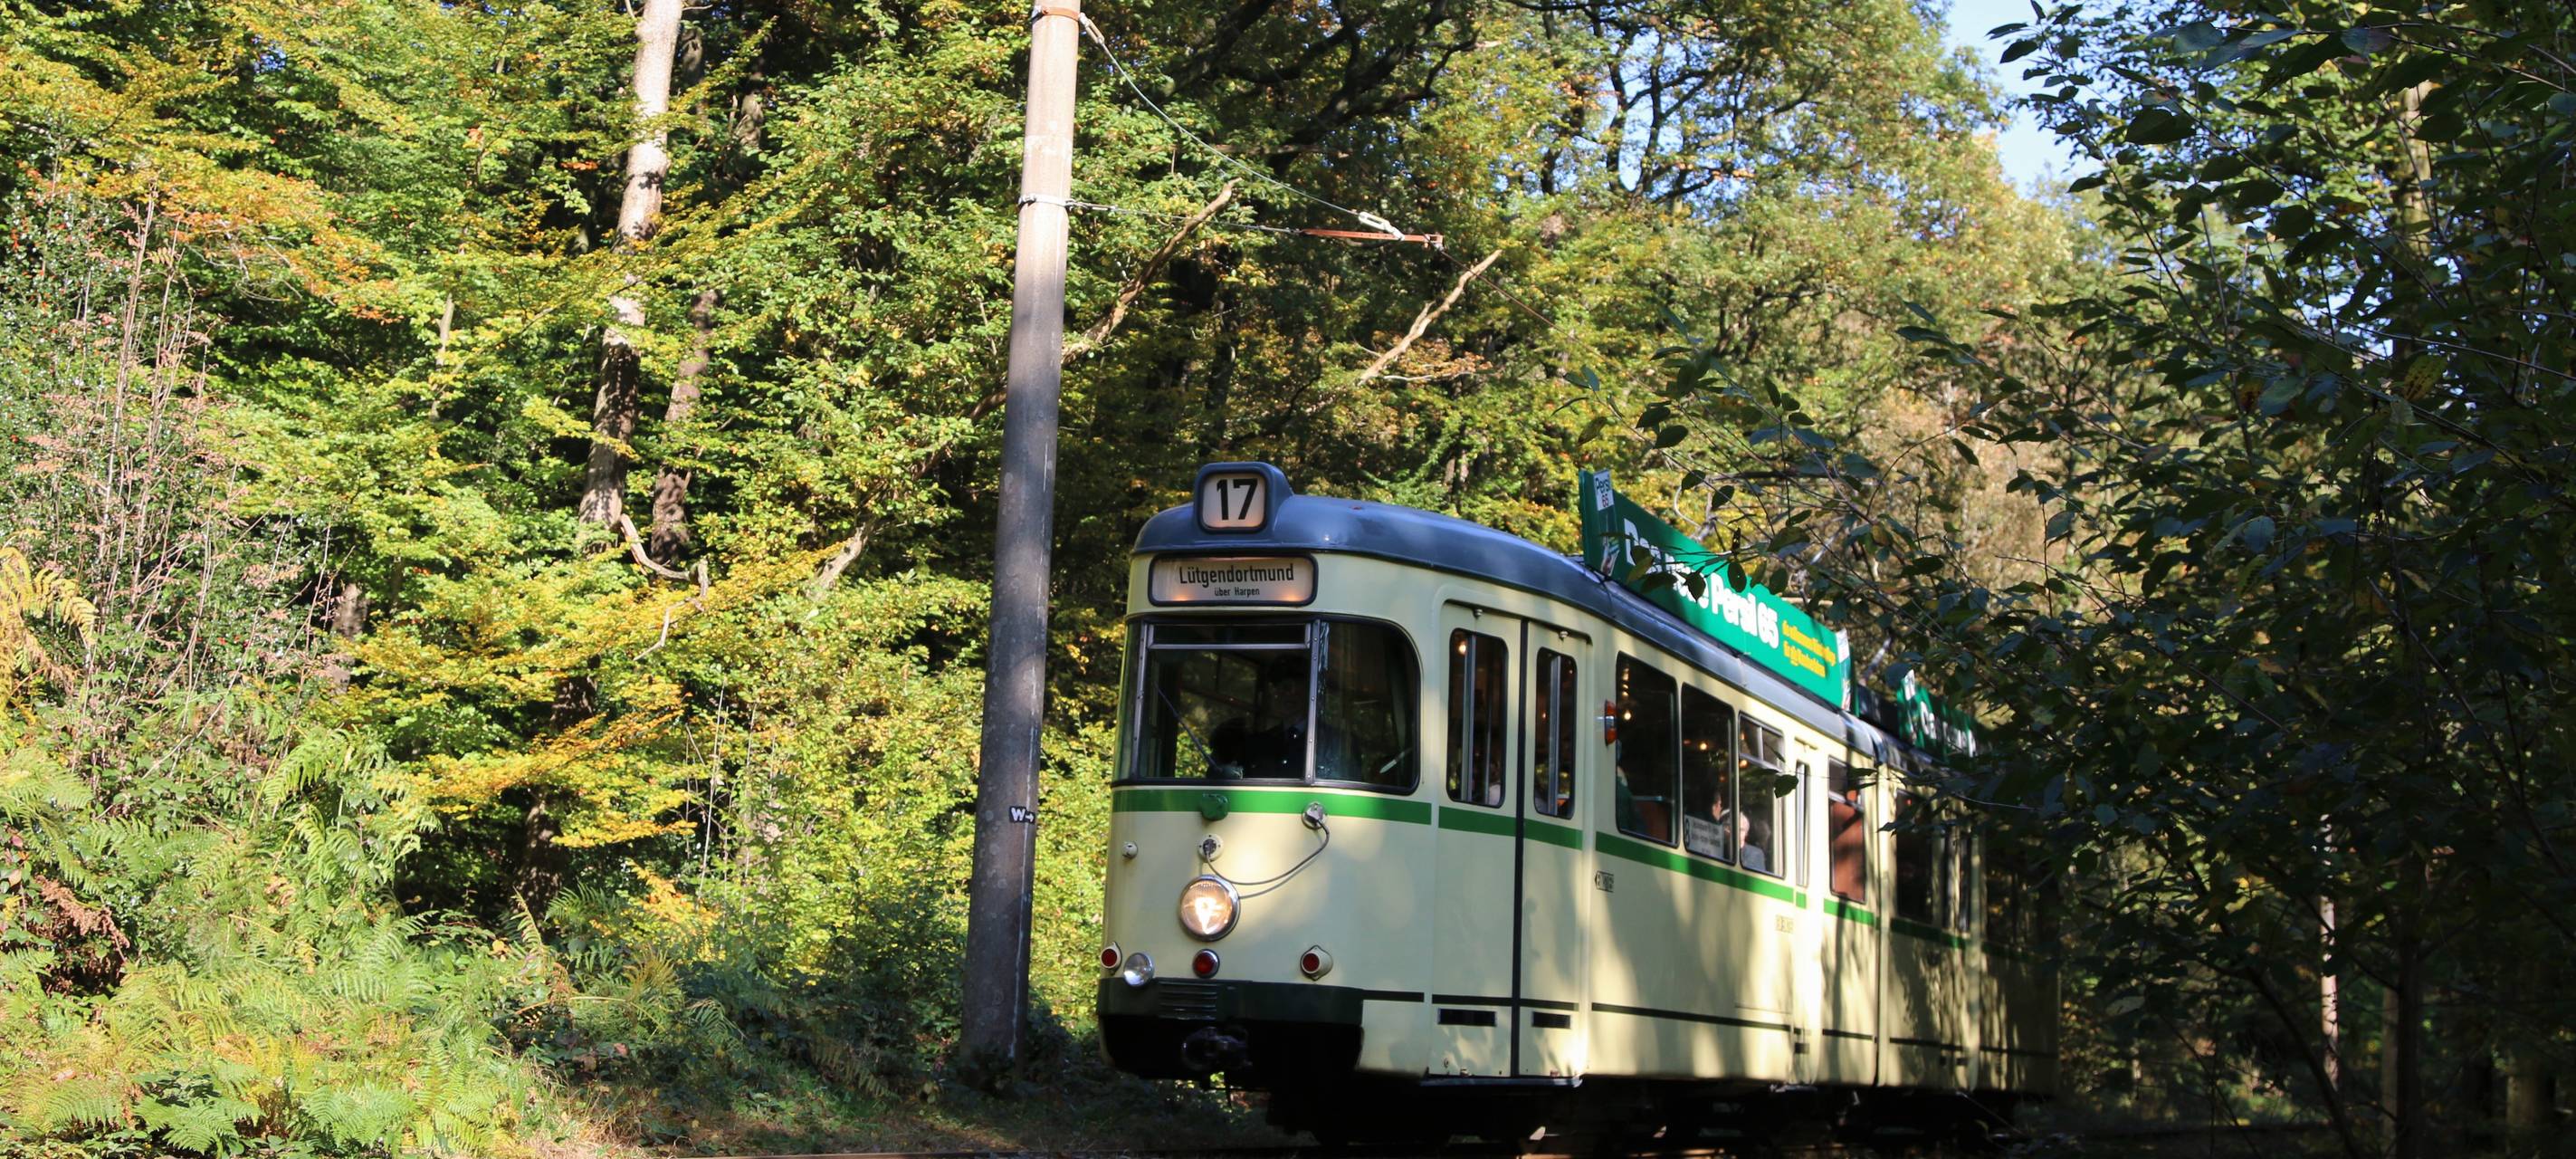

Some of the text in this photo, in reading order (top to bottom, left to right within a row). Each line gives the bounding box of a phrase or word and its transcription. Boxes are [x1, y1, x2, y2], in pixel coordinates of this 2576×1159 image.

[1216, 478, 1258, 521] 17
[1179, 563, 1294, 588] Lütgendortmund
[1215, 586, 1260, 598] über Harpen
[1711, 572, 1757, 637] Persil
[1758, 601, 1779, 649] 65
[1011, 807, 1026, 821] W
